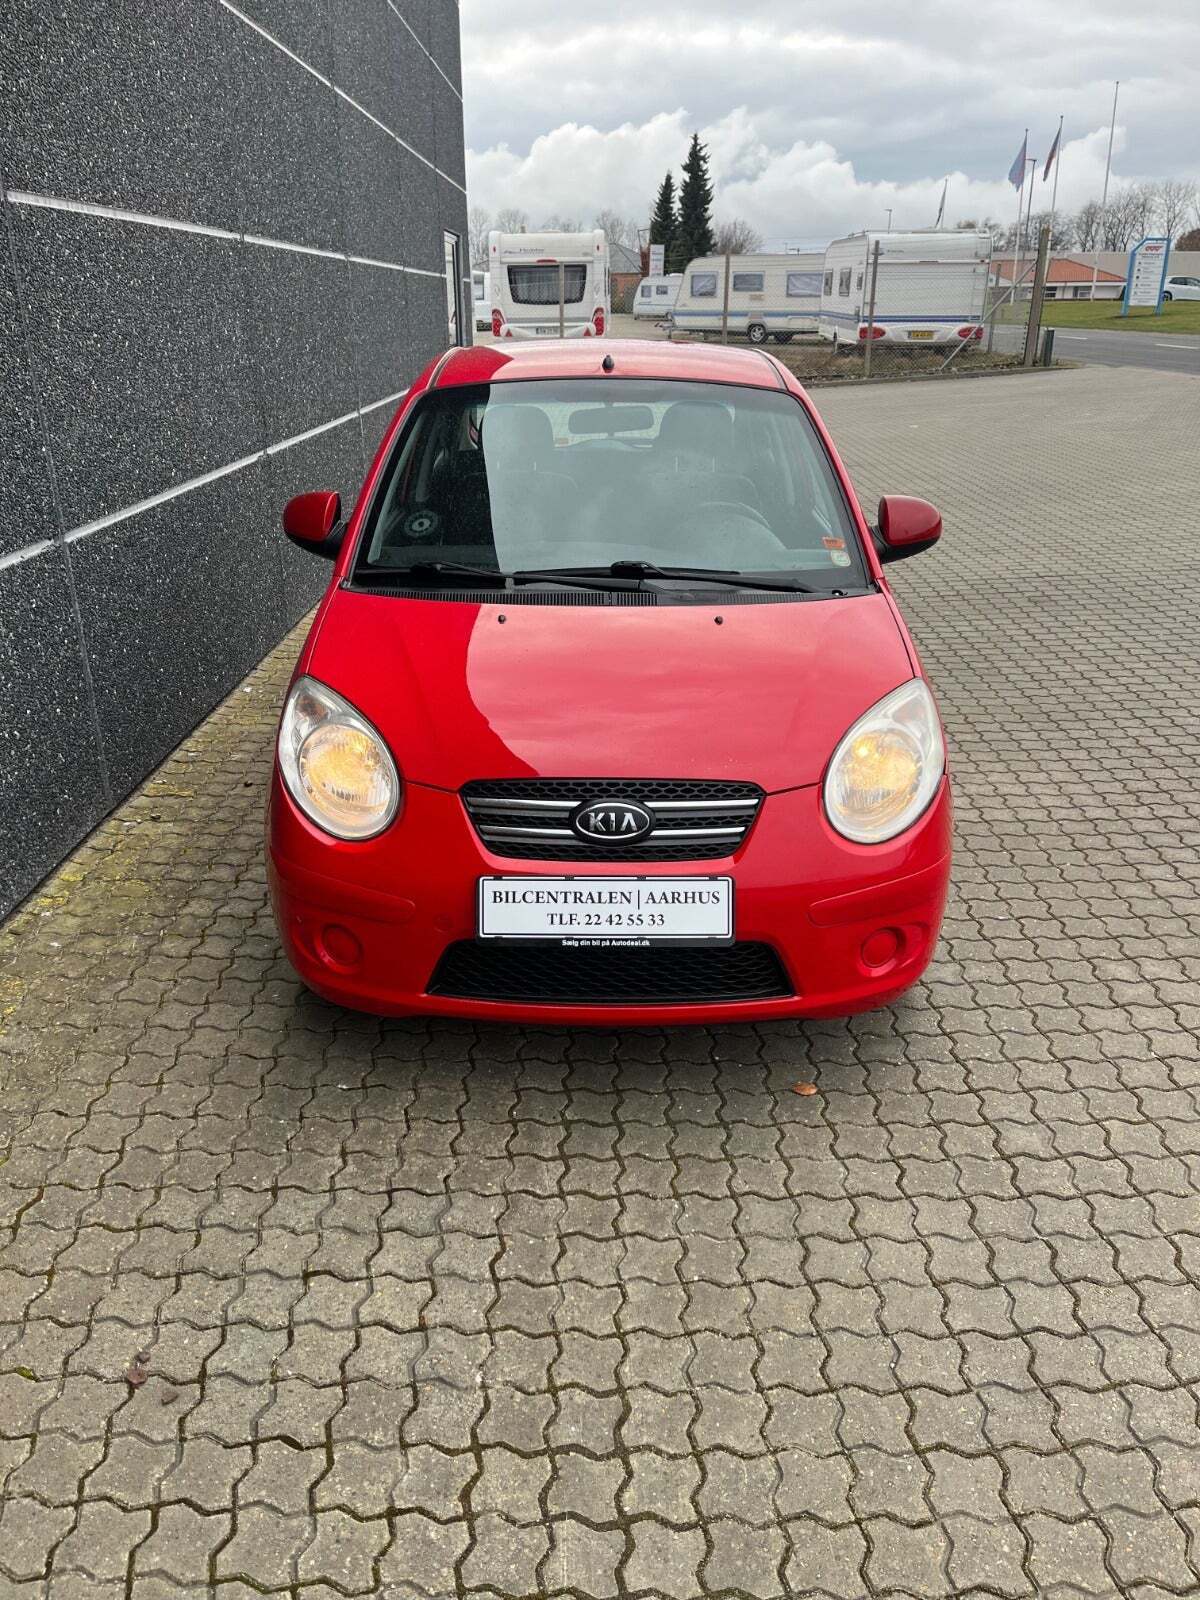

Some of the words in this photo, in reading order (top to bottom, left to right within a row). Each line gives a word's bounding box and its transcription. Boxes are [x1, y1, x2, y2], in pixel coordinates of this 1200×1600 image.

[588, 812, 638, 832] KIA
[492, 890, 633, 905] BILCENTRALEN
[645, 890, 721, 905] AARHUS
[547, 913, 581, 926] TLF.
[584, 913, 602, 926] 22
[605, 913, 623, 926] 42
[626, 913, 644, 926] 55
[647, 913, 665, 926] 33
[562, 939, 579, 947] Sælg
[601, 939, 611, 947] på
